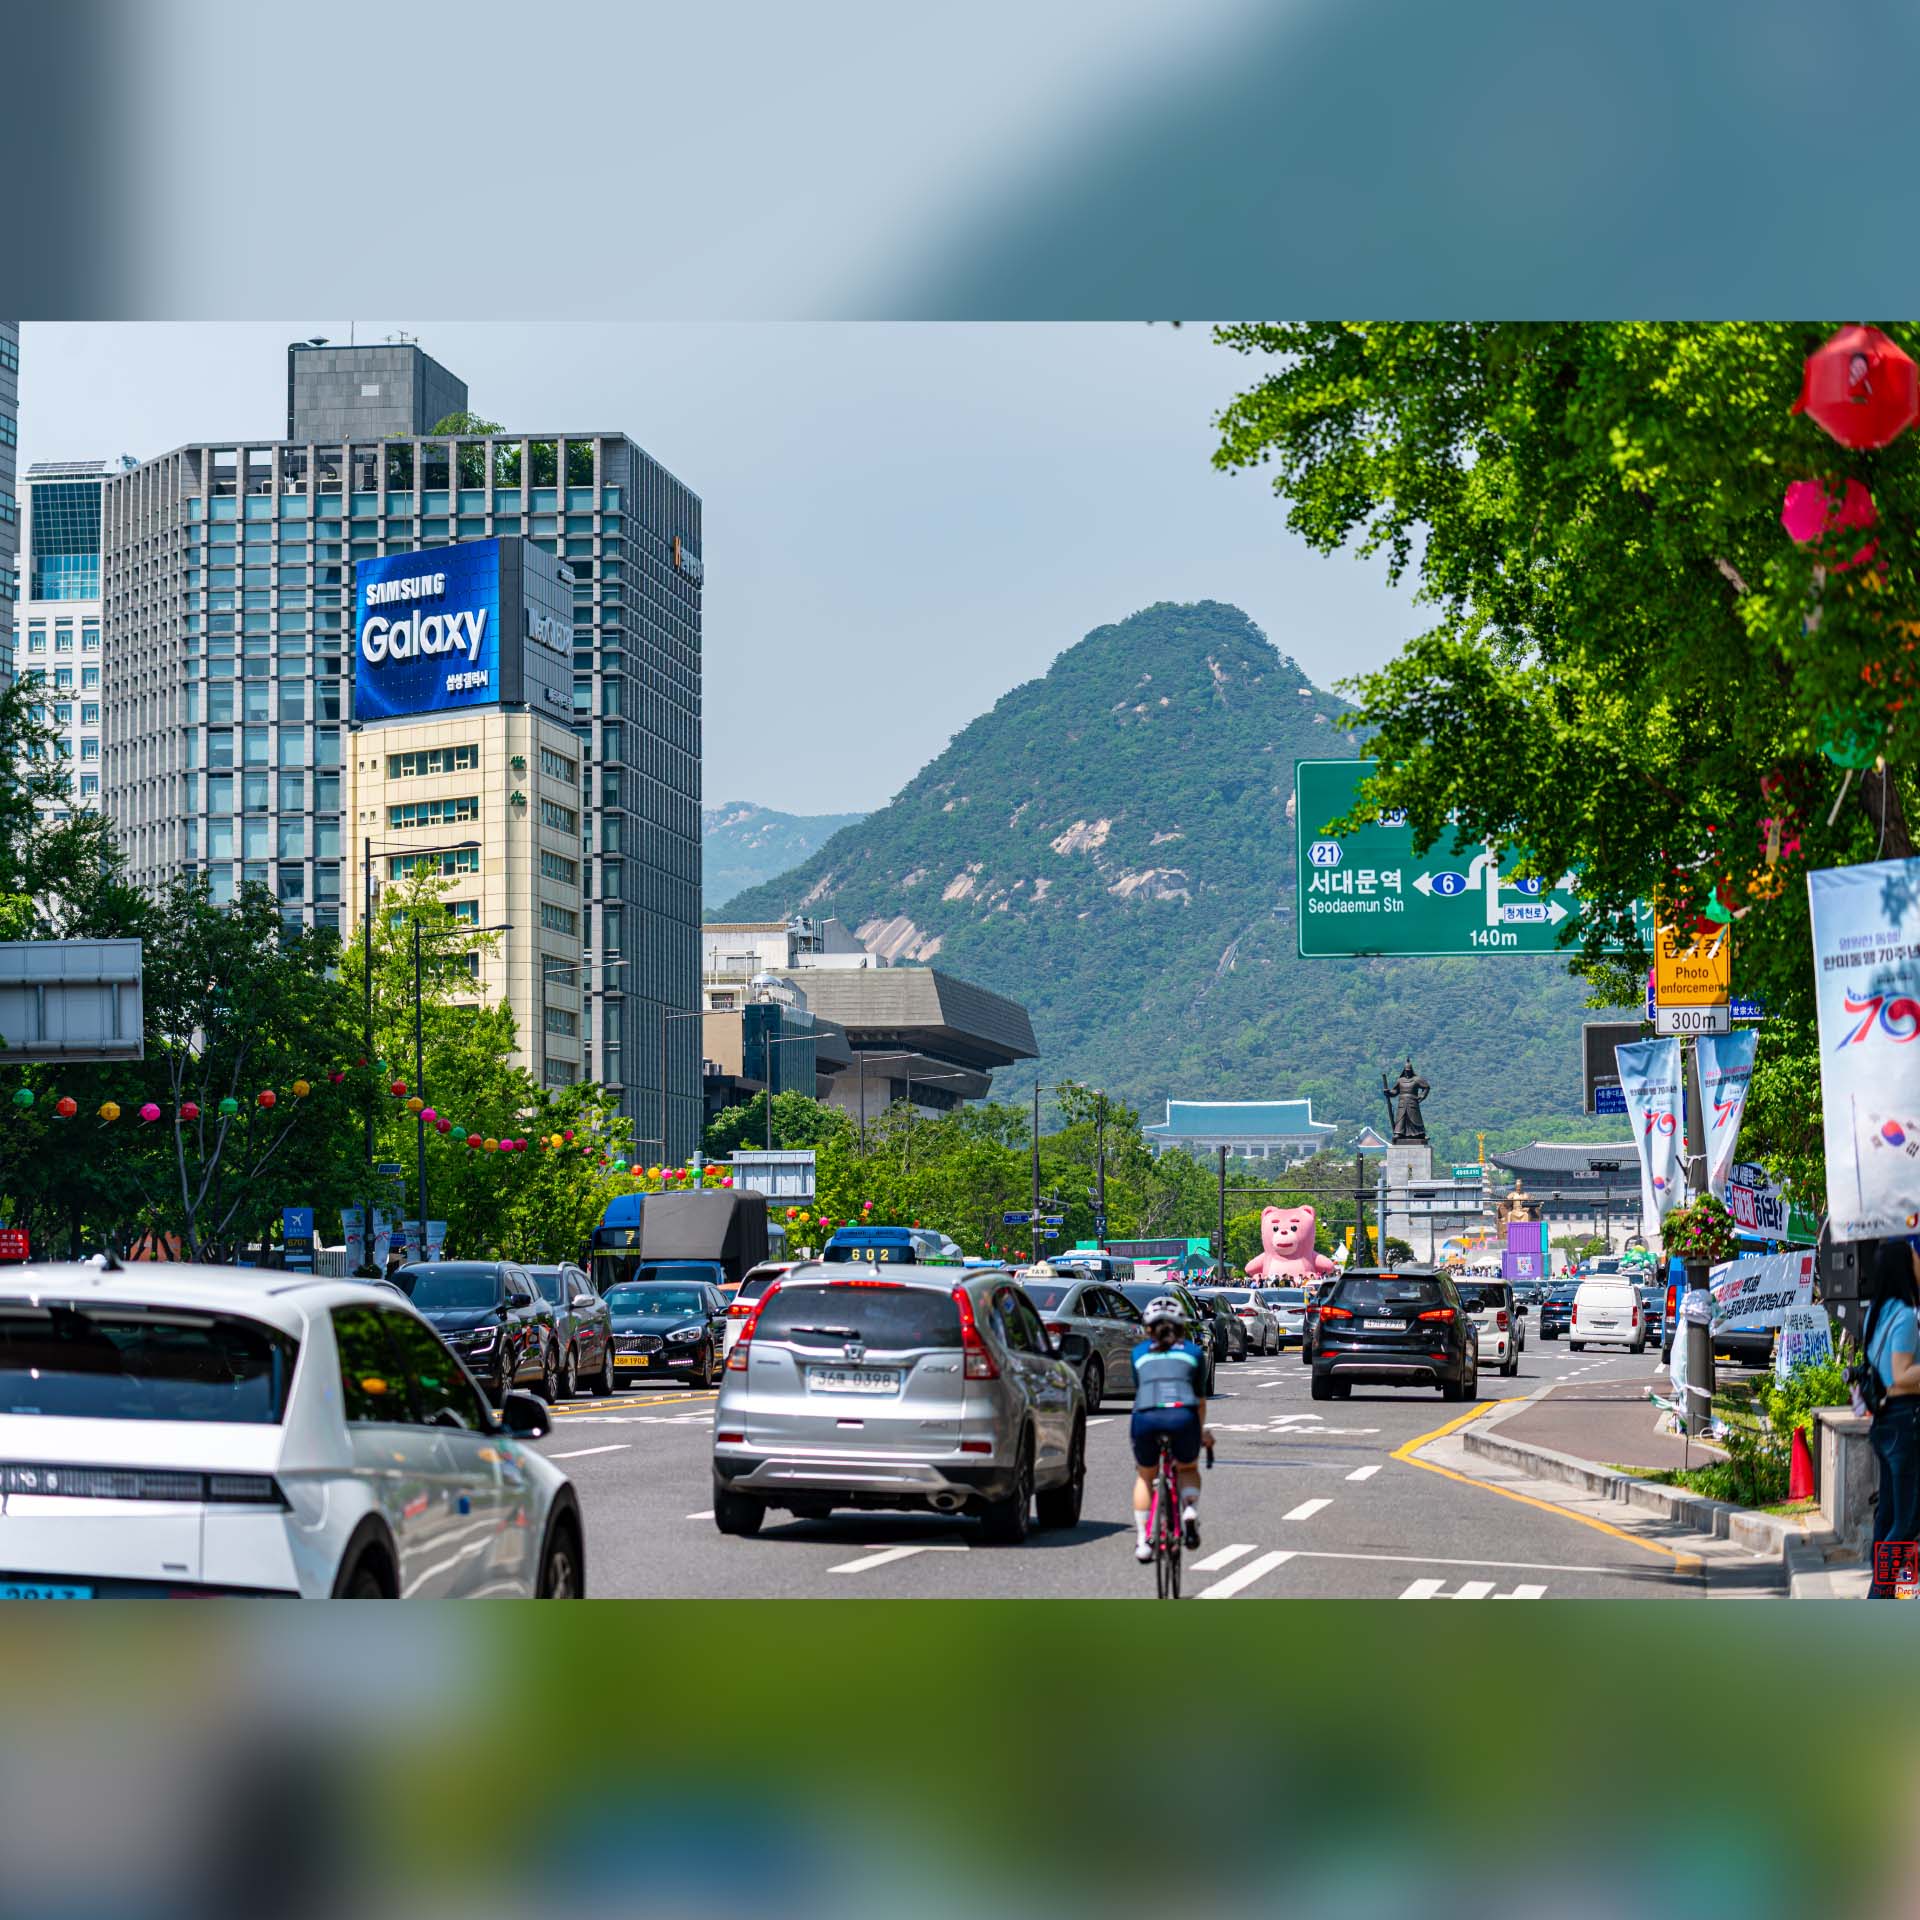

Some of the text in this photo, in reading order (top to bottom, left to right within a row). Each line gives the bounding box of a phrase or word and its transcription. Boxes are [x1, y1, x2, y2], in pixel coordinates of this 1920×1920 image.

[366, 573, 446, 606] SAMSUNG
[361, 608, 487, 663] Galaxy
[1317, 846, 1335, 863] 21
[1307, 869, 1402, 895] 서대문역
[1442, 875, 1454, 893] 6
[1527, 877, 1539, 892] 6
[1308, 897, 1404, 913] Seodaemun Stn
[1506, 905, 1543, 920] 청계천로
[1470, 928, 1518, 946] 140m
[1675, 966, 1709, 979] Photo
[1660, 982, 1727, 994] enforcement
[1672, 1012, 1716, 1030] 300m
[852, 1248, 889, 1261] 602
[853, 1372, 891, 1388] 0398
